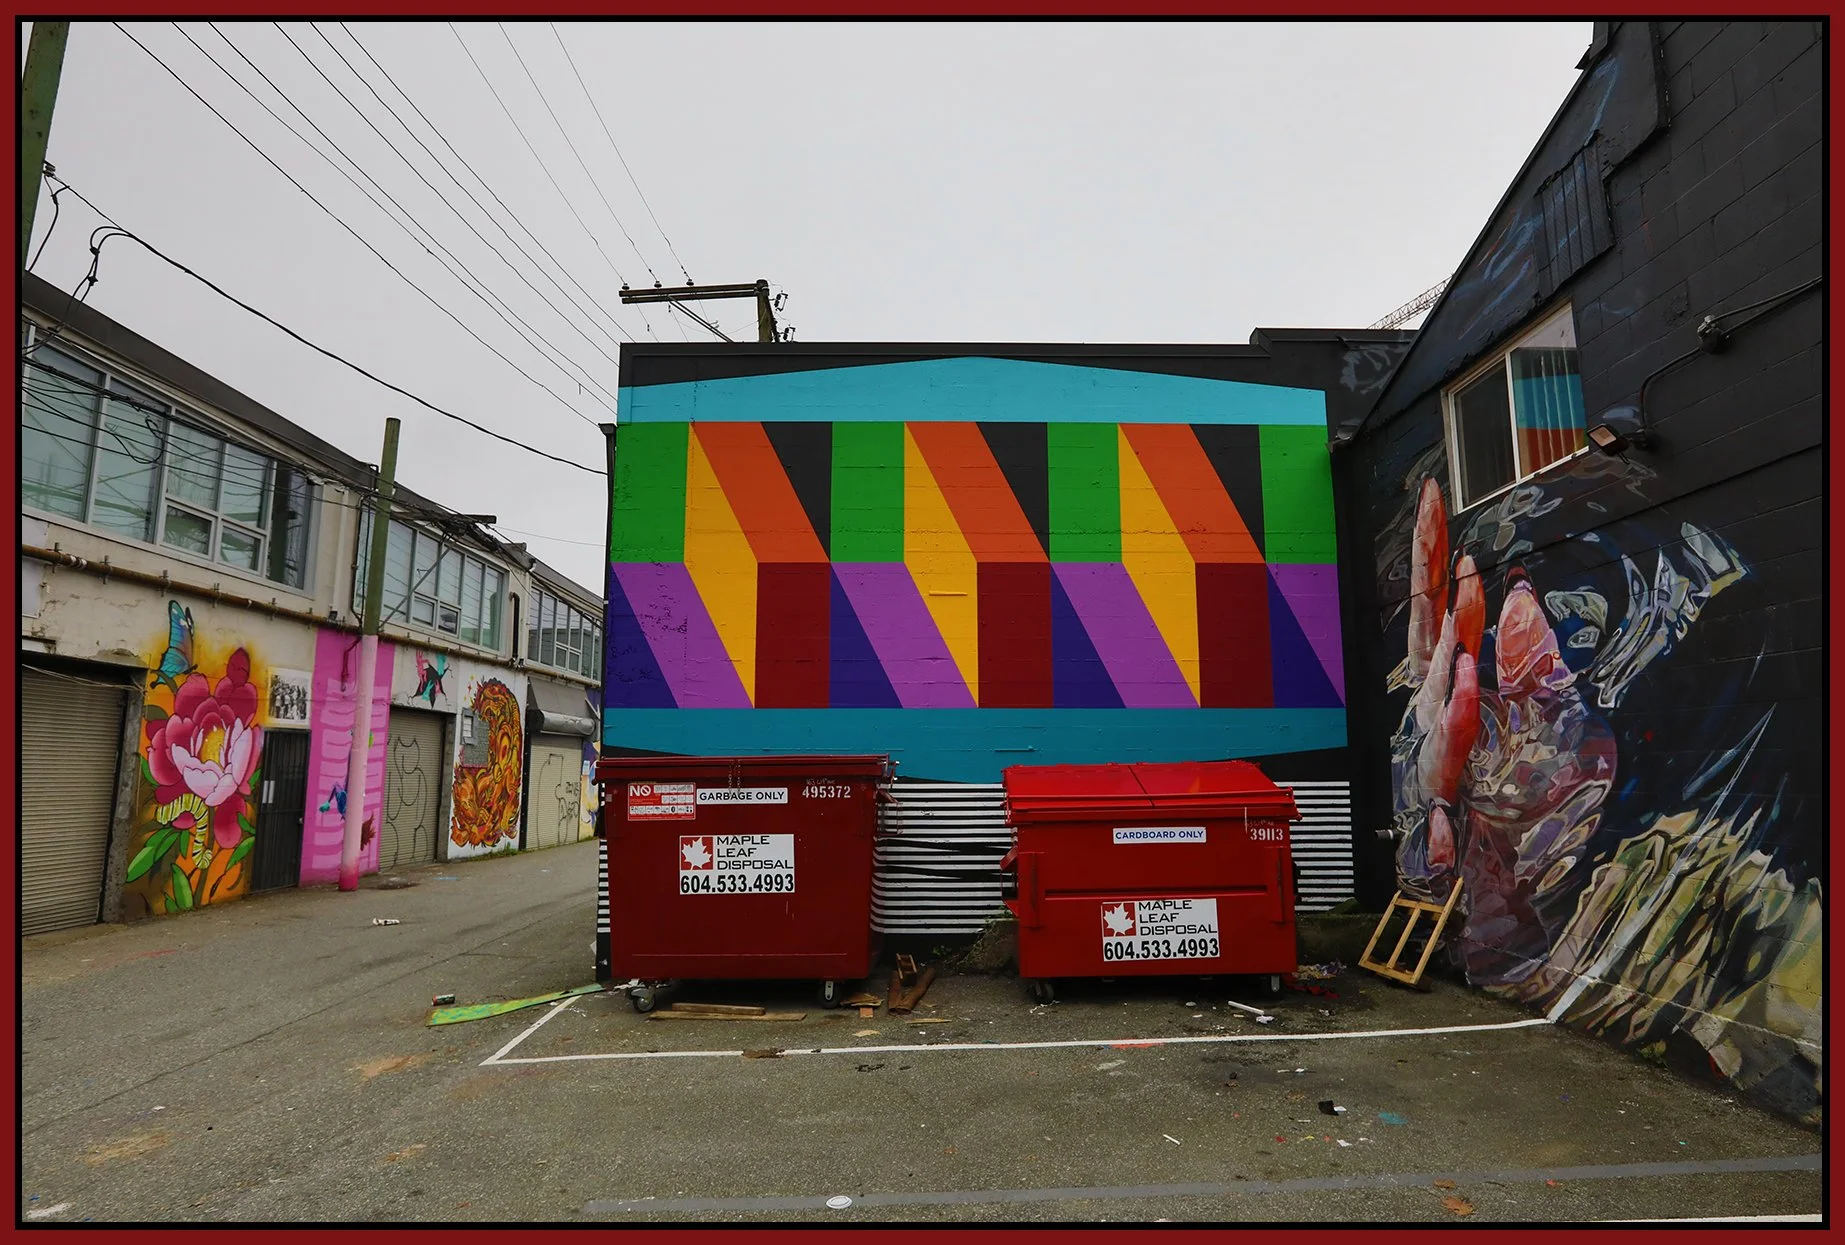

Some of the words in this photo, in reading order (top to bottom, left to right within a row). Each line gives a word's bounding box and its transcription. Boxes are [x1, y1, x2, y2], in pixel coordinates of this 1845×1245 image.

[629, 784, 652, 797] NO
[699, 791, 752, 801] GARBAGE
[755, 791, 785, 800] ONLY
[802, 785, 851, 799] 495372
[717, 835, 770, 845] MAPLE
[1115, 831, 1176, 840] CARDBOARD
[1178, 830, 1204, 839] ONLY
[1250, 828, 1284, 841] 39113
[717, 848, 757, 858] LEAF
[717, 859, 794, 870] DISPOSAL
[680, 873, 794, 894] 604.533.4993
[1138, 899, 1193, 911] MAPLE
[1139, 912, 1180, 924] LEAF
[1140, 924, 1218, 936] DISPOSAL
[1103, 937, 1219, 961] 604.533.4993
